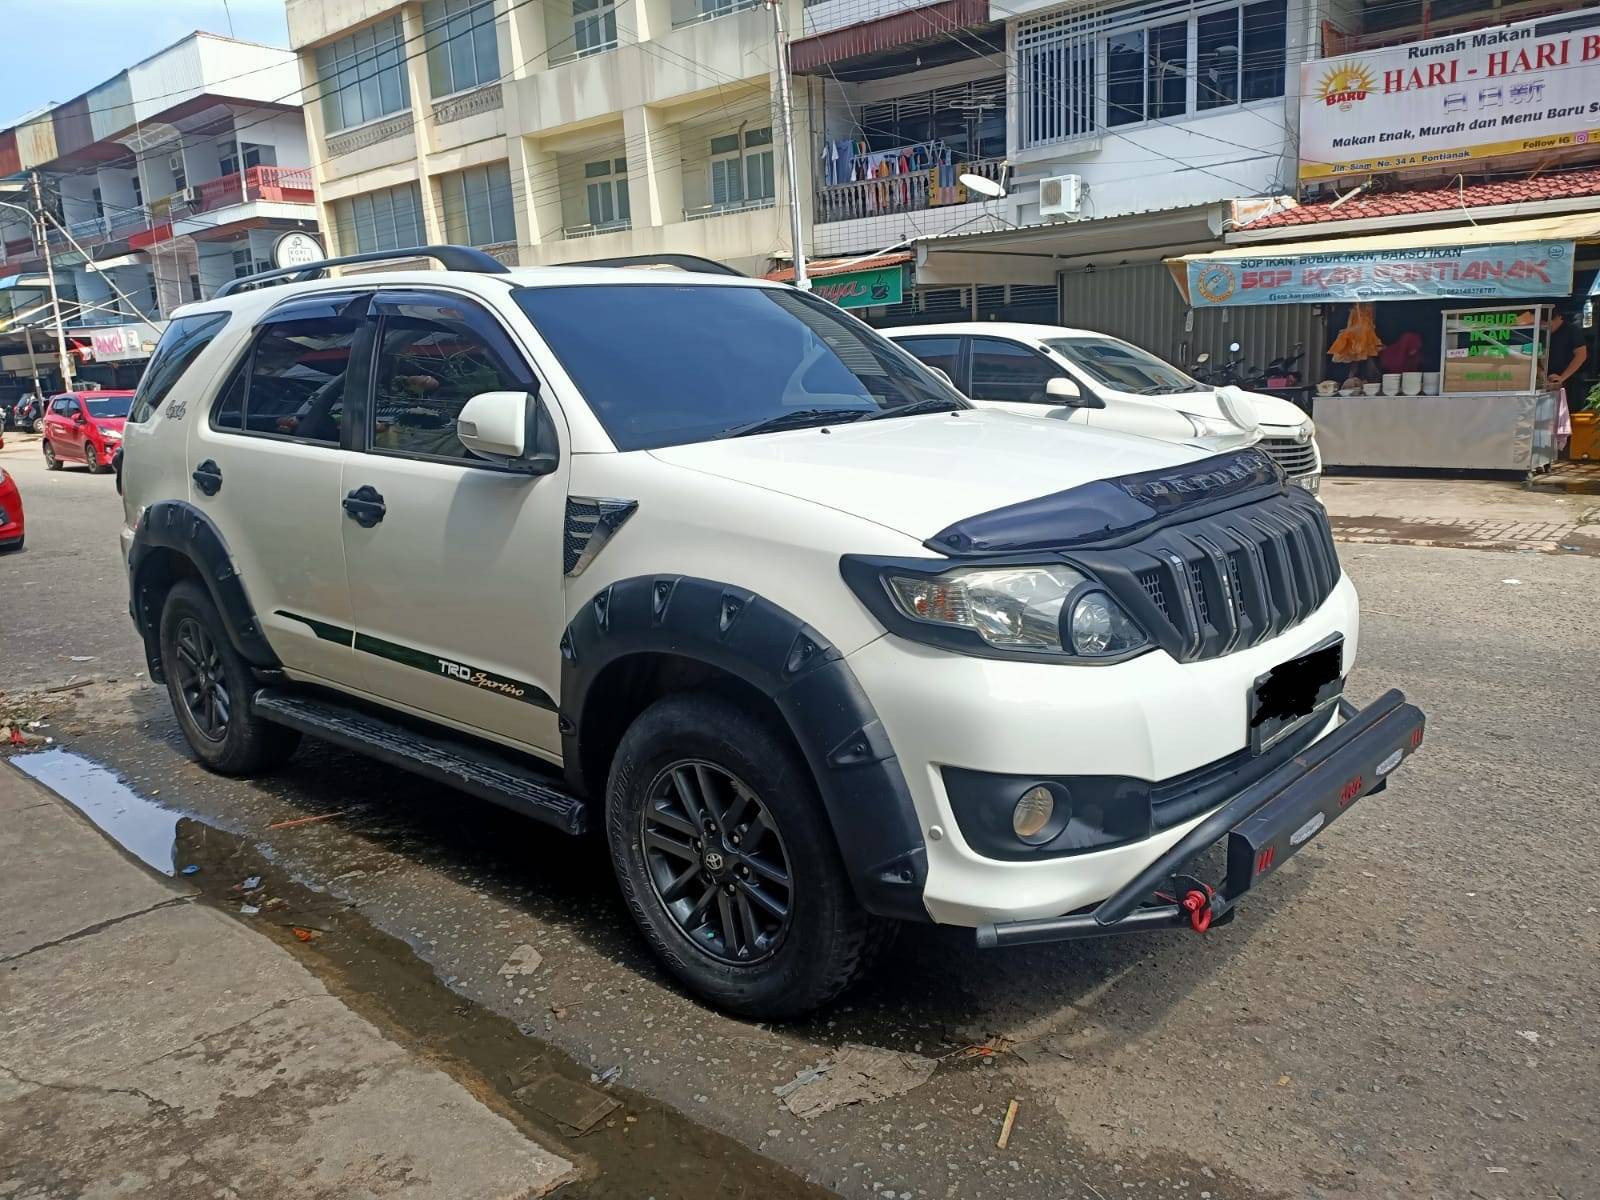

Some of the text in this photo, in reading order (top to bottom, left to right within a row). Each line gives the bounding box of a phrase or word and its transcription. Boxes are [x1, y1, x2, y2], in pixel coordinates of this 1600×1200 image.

[1408, 27, 1531, 59] Rumah Makan
[1384, 59, 1460, 94] HARI
[1487, 38, 1571, 78] HARI
[1326, 91, 1367, 106] BARU
[1332, 135, 1375, 148] Makan
[1379, 129, 1415, 143] Enak,
[1419, 119, 1465, 137] Murah
[1468, 118, 1497, 130] dan
[1501, 111, 1543, 126] Menu
[1547, 105, 1585, 119] Baru
[1522, 136, 1570, 150] Follow IG
[1350, 162, 1372, 171] Siam
[1395, 158, 1406, 166] 34
[1421, 150, 1471, 163] Pontianak
[1240, 247, 1462, 269] SOP IKAN, BUBUR IKAN, BAKSO IKAN
[1241, 270, 1292, 288] SOP
[1374, 260, 1551, 284] PONTIANAK
[1464, 313, 1517, 326] BUBUR
[1470, 328, 1511, 341] IKAN
[438, 660, 525, 697] TRD Sportivo
